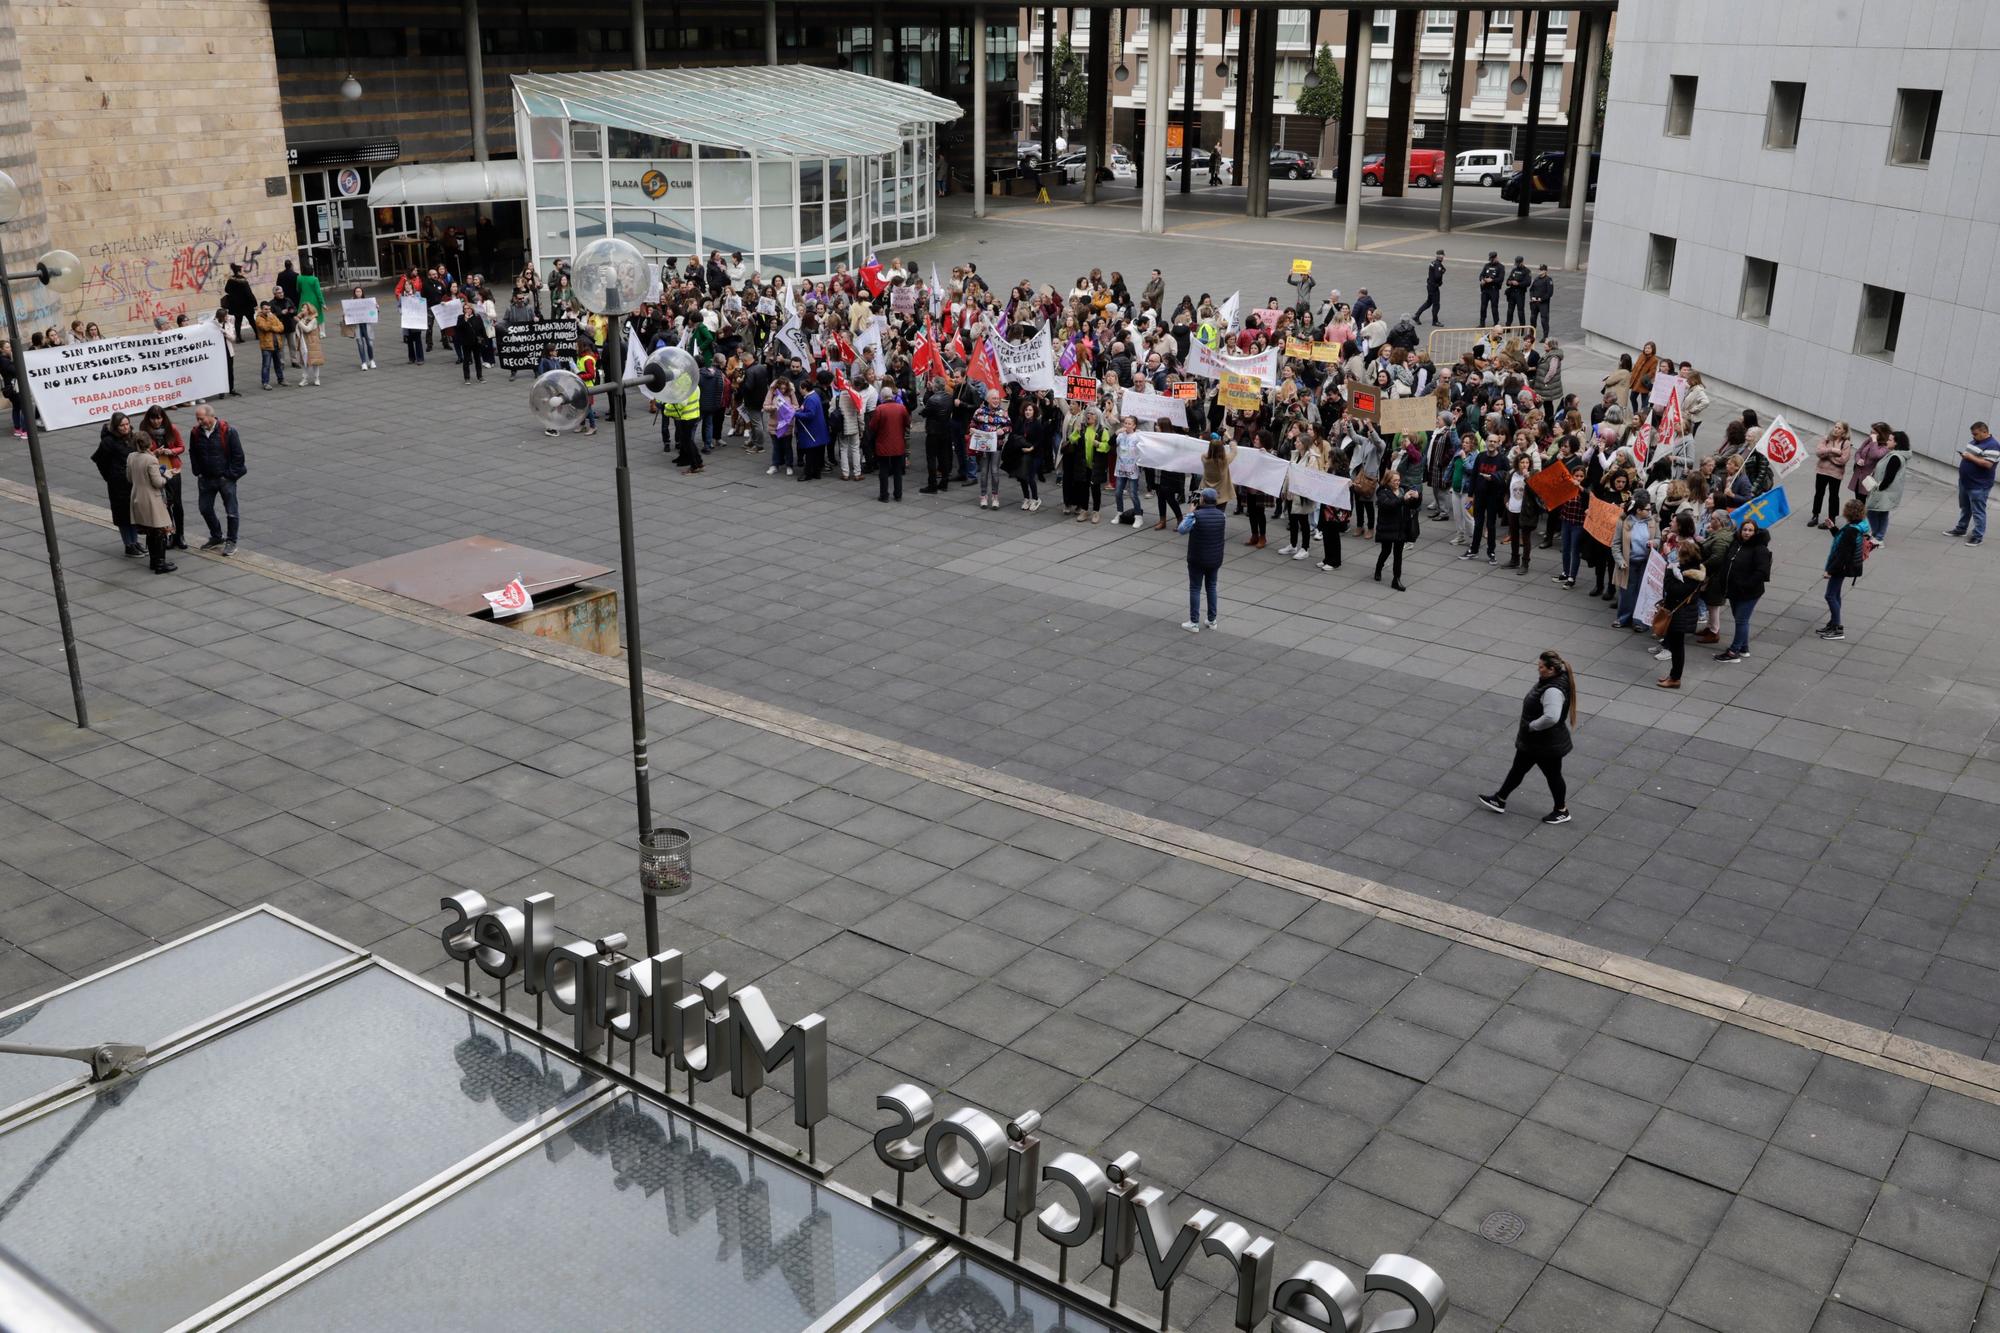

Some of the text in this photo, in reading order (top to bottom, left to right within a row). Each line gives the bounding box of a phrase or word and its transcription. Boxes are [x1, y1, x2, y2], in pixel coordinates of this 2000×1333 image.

[612, 180, 639, 188] PLAZA
[670, 180, 693, 188] CLUB
[507, 324, 530, 334] SOMOS
[541, 332, 553, 340] TUS
[61, 349, 84, 358] SIN
[28, 366, 51, 378] SIN
[138, 348, 160, 359] SIN
[44, 353, 210, 389] NO HAY CALIDAD ASISTENCIAL
[154, 379, 174, 391] DEL
[175, 375, 193, 386] ERA
[1068, 377, 1096, 387] SE VENDE
[89, 390, 182, 416] CPR CLARA FERRER
